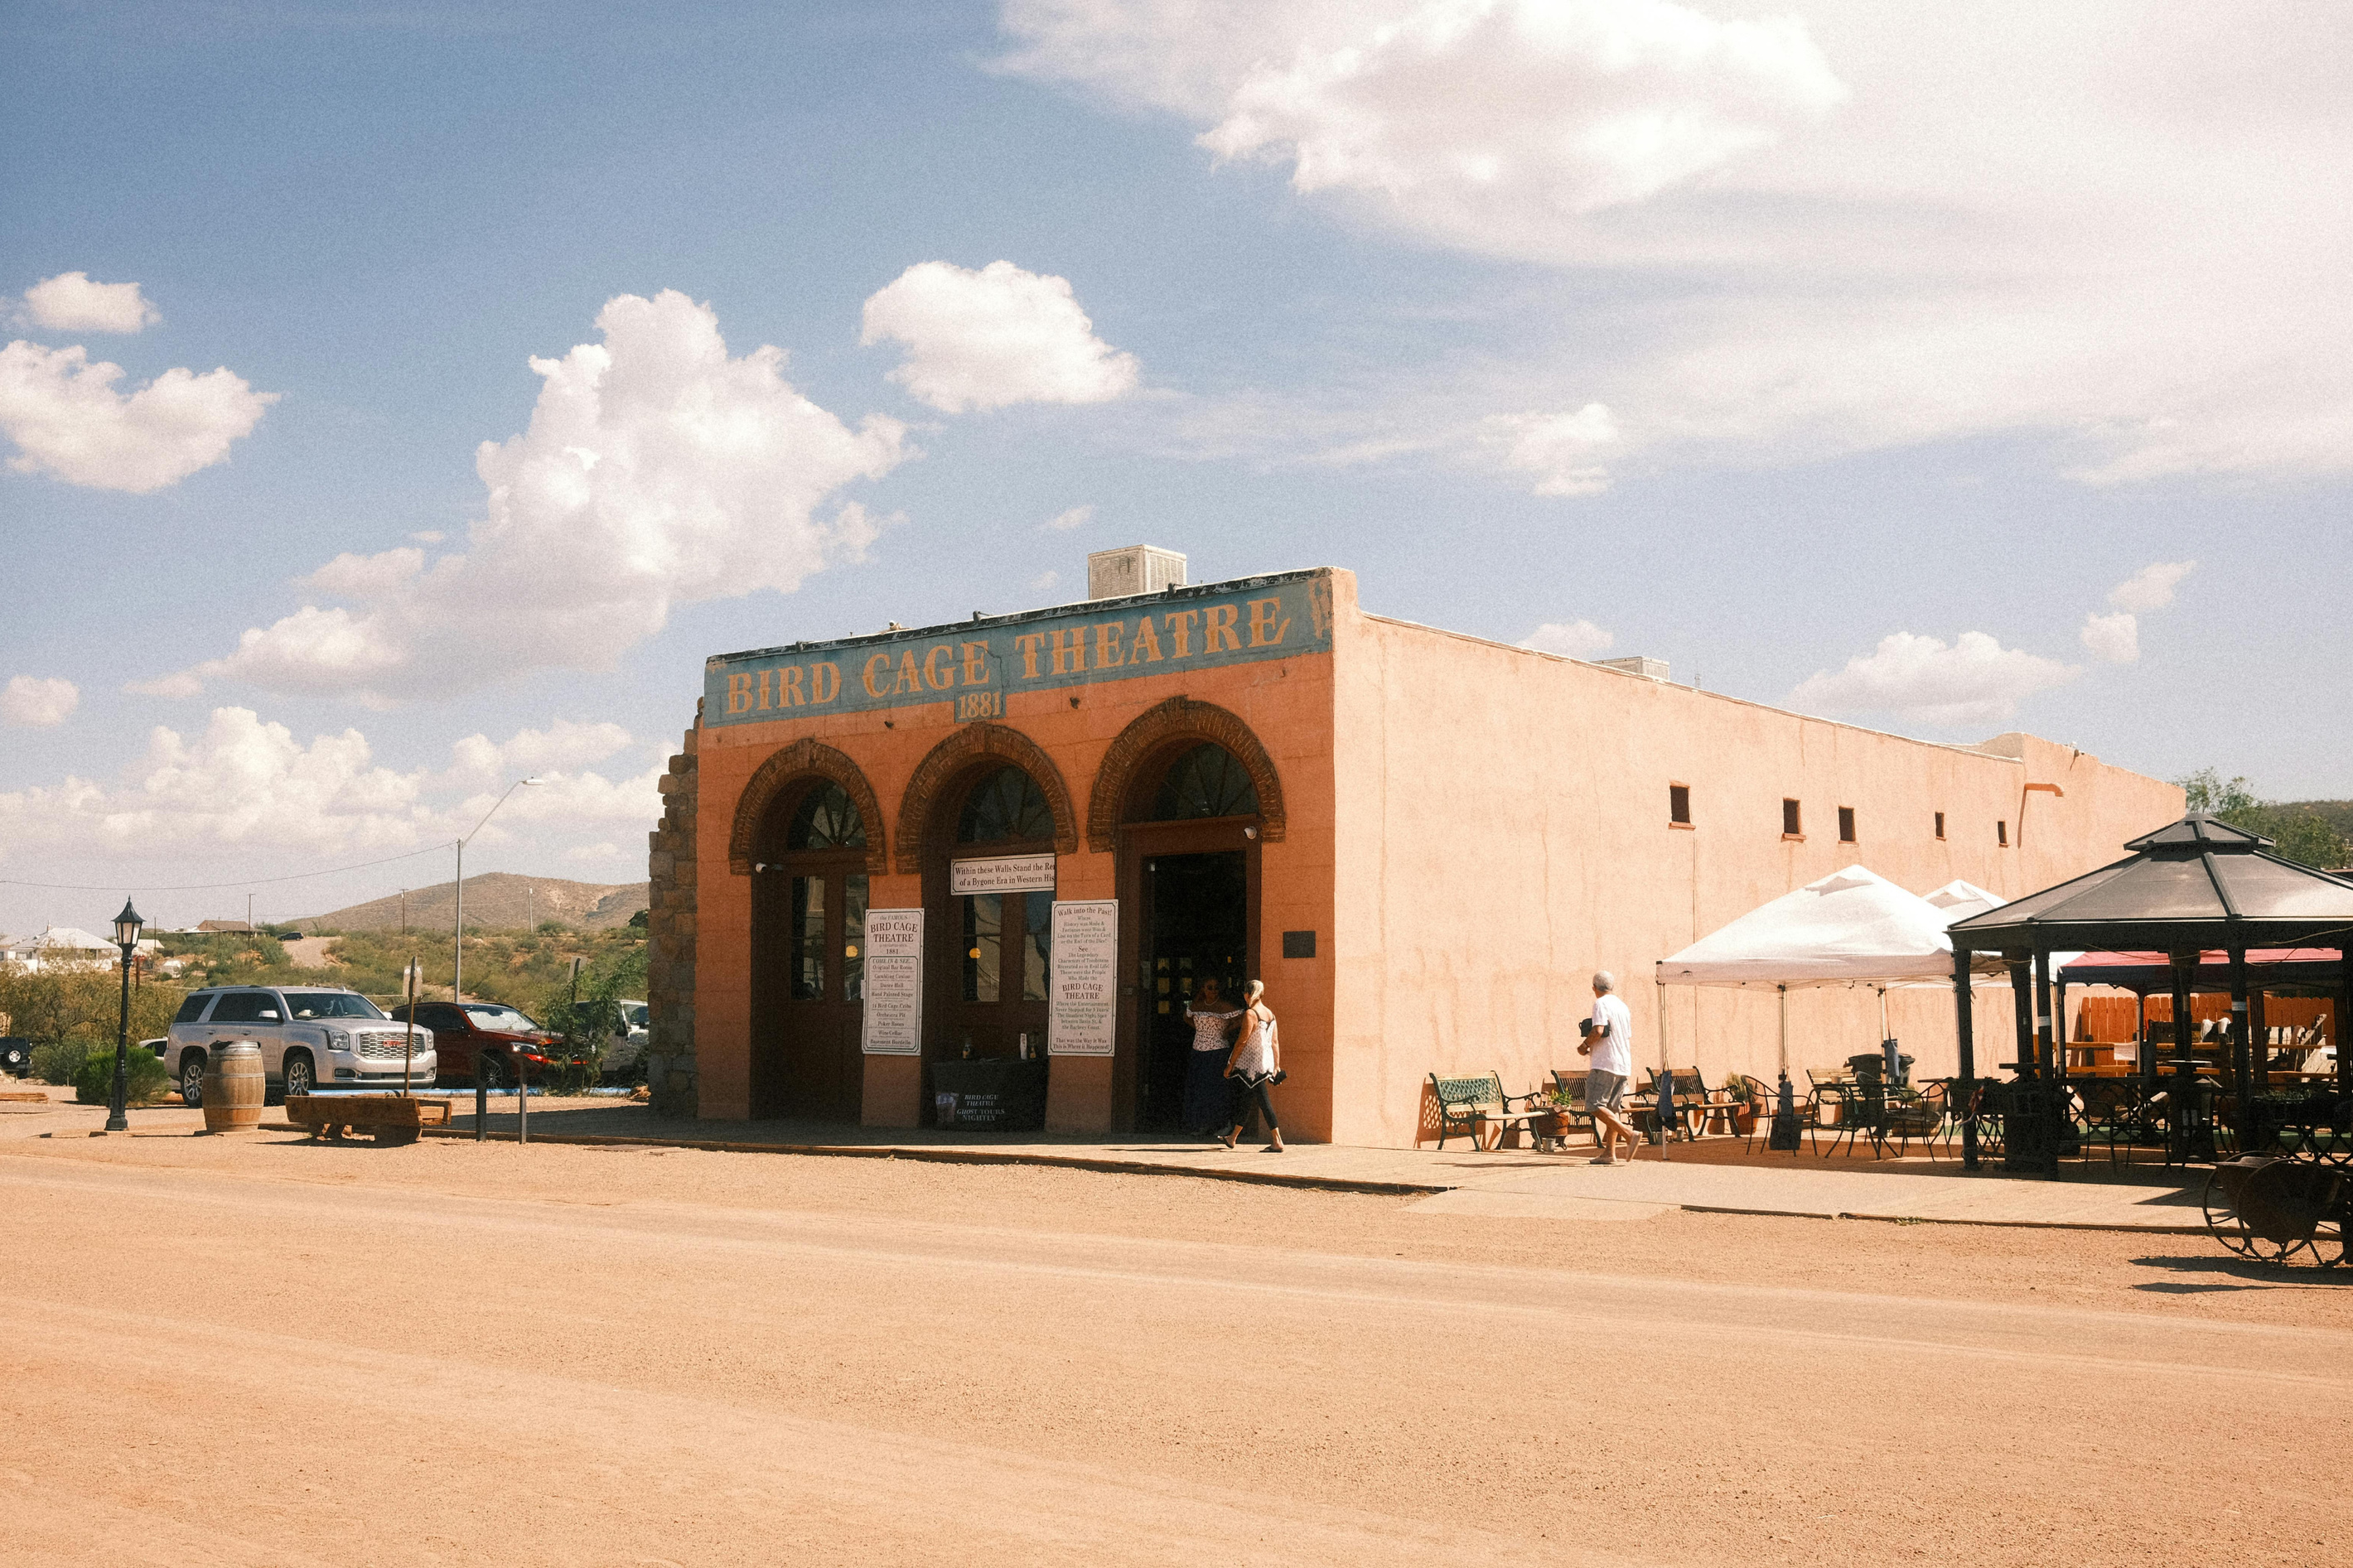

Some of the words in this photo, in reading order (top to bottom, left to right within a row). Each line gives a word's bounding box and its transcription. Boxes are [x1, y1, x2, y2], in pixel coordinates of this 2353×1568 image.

[726, 661, 842, 714] BIRD
[862, 640, 990, 698] CAGE
[1015, 596, 1291, 679] THEATRE
[958, 691, 1001, 719] 1881
[955, 866, 976, 876] Within
[978, 866, 994, 874] these
[995, 864, 1012, 873] Walls
[1012, 863, 1032, 872] Stand
[1033, 862, 1043, 871] the
[959, 878, 967, 886] of
[972, 877, 995, 887] Bygone
[996, 876, 1007, 885] Era
[1017, 875, 1042, 884] Western
[1058, 908, 1072, 917] Walk
[1098, 908, 1112, 916] Past!
[871, 923, 891, 933] BIRD
[893, 922, 918, 933] CAGE
[873, 934, 914, 943] THEATRE
[1062, 983, 1080, 991] BIRD
[1083, 982, 1104, 991] CAGE
